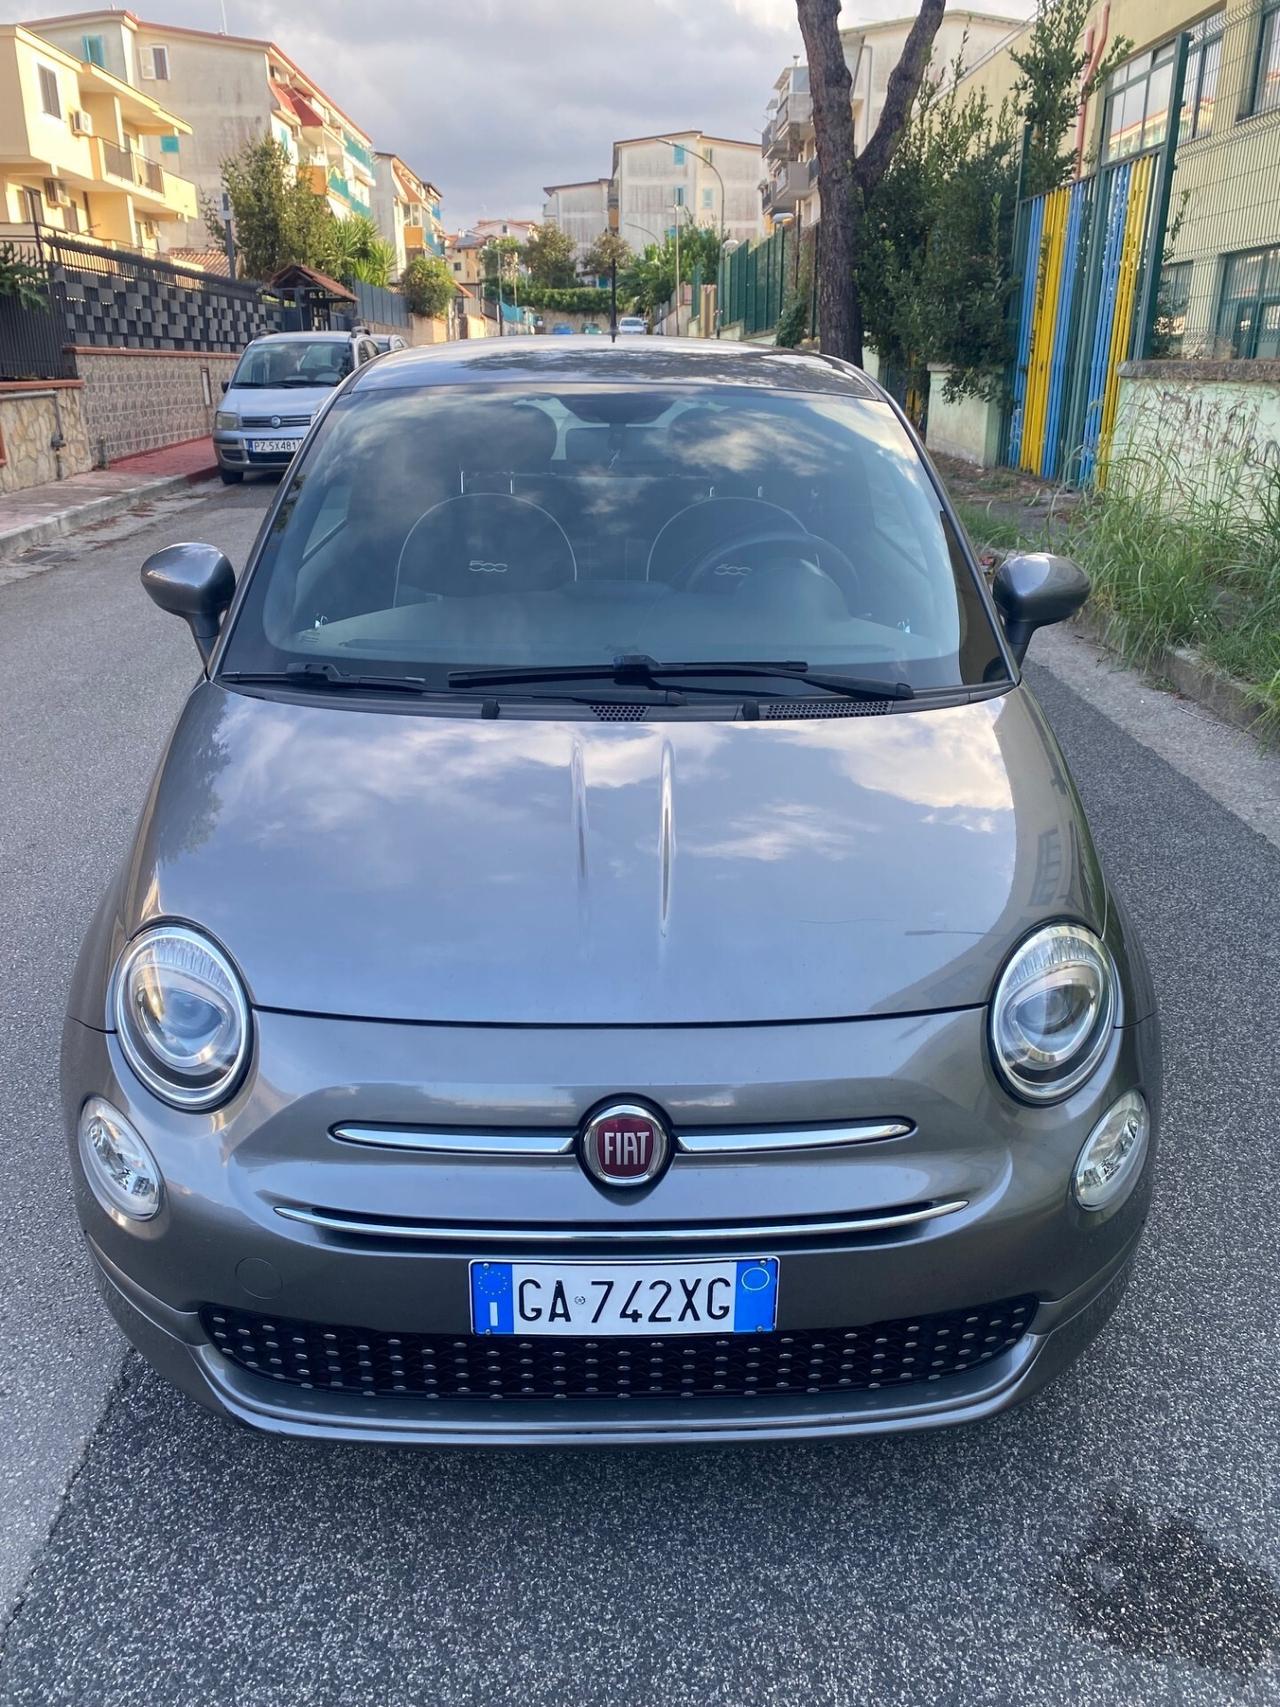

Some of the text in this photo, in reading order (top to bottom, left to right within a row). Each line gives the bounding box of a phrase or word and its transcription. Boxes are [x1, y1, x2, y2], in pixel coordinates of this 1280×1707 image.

[254, 441, 266, 451] PZ
[468, 560, 508, 573] 500
[604, 1131, 650, 1166] FIAT
[518, 1277, 732, 1323] GA 742XG
